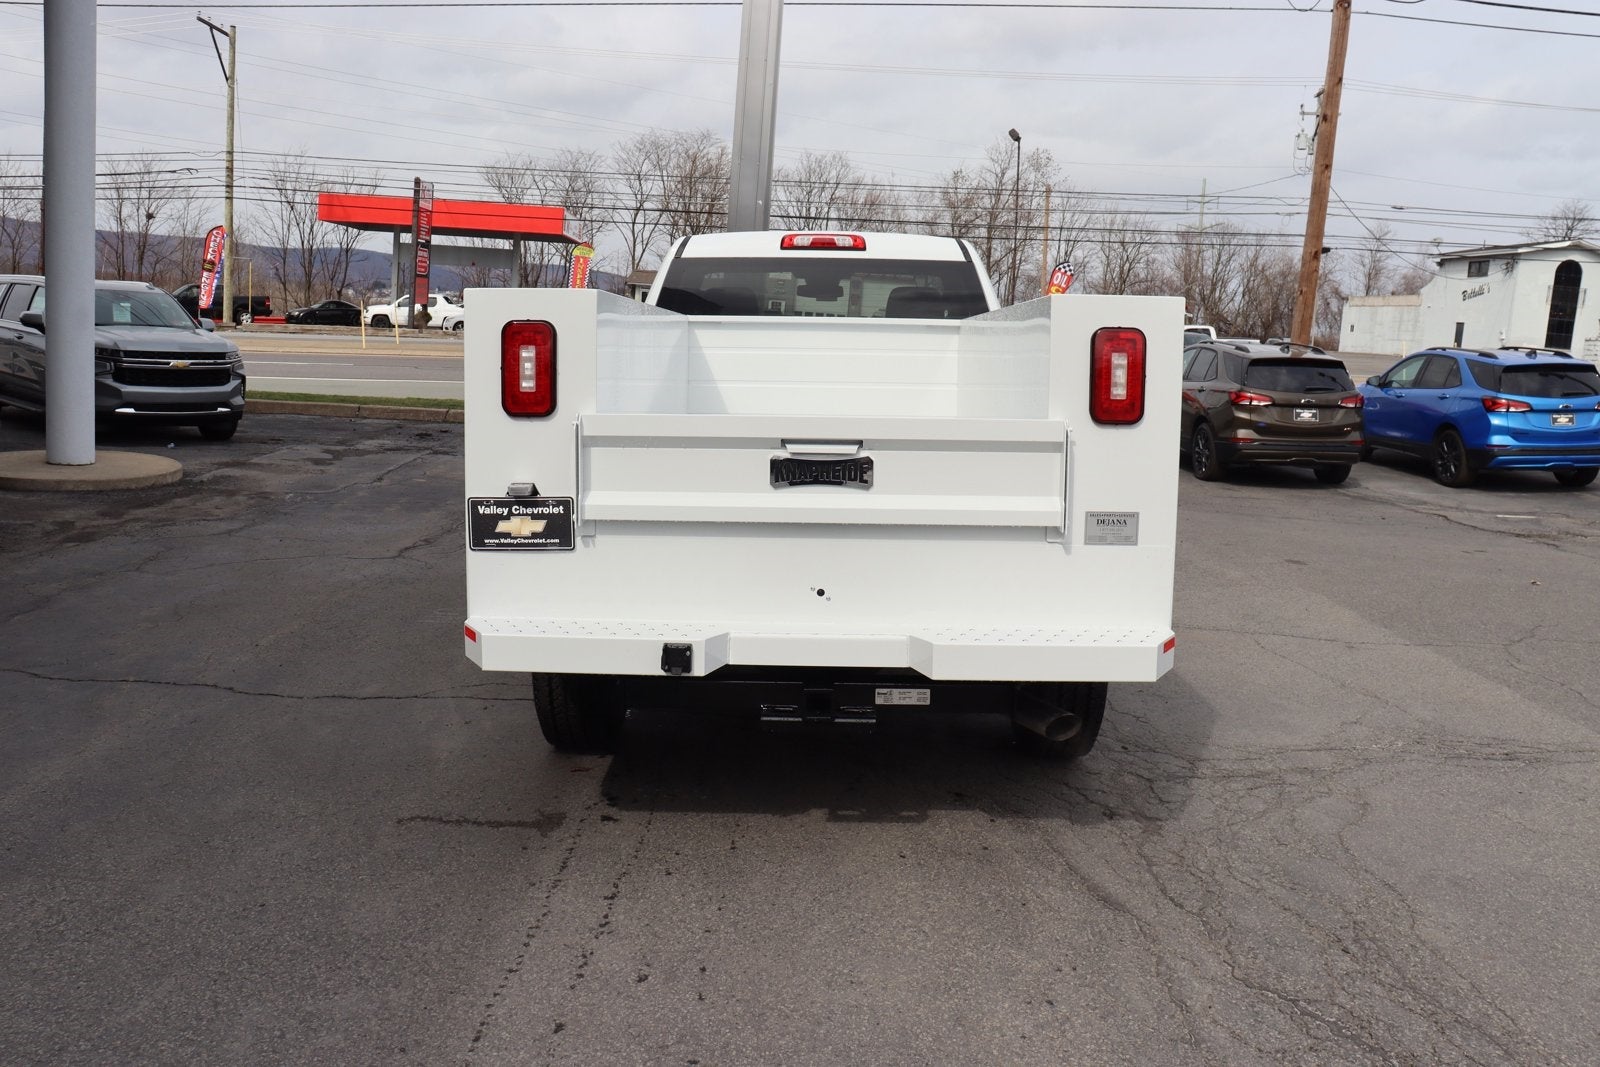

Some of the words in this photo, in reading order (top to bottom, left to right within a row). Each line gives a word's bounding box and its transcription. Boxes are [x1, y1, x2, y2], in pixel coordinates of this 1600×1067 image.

[1053, 272, 1068, 288] OIL
[478, 505, 509, 516] Valley
[511, 505, 564, 515] Chevrolet
